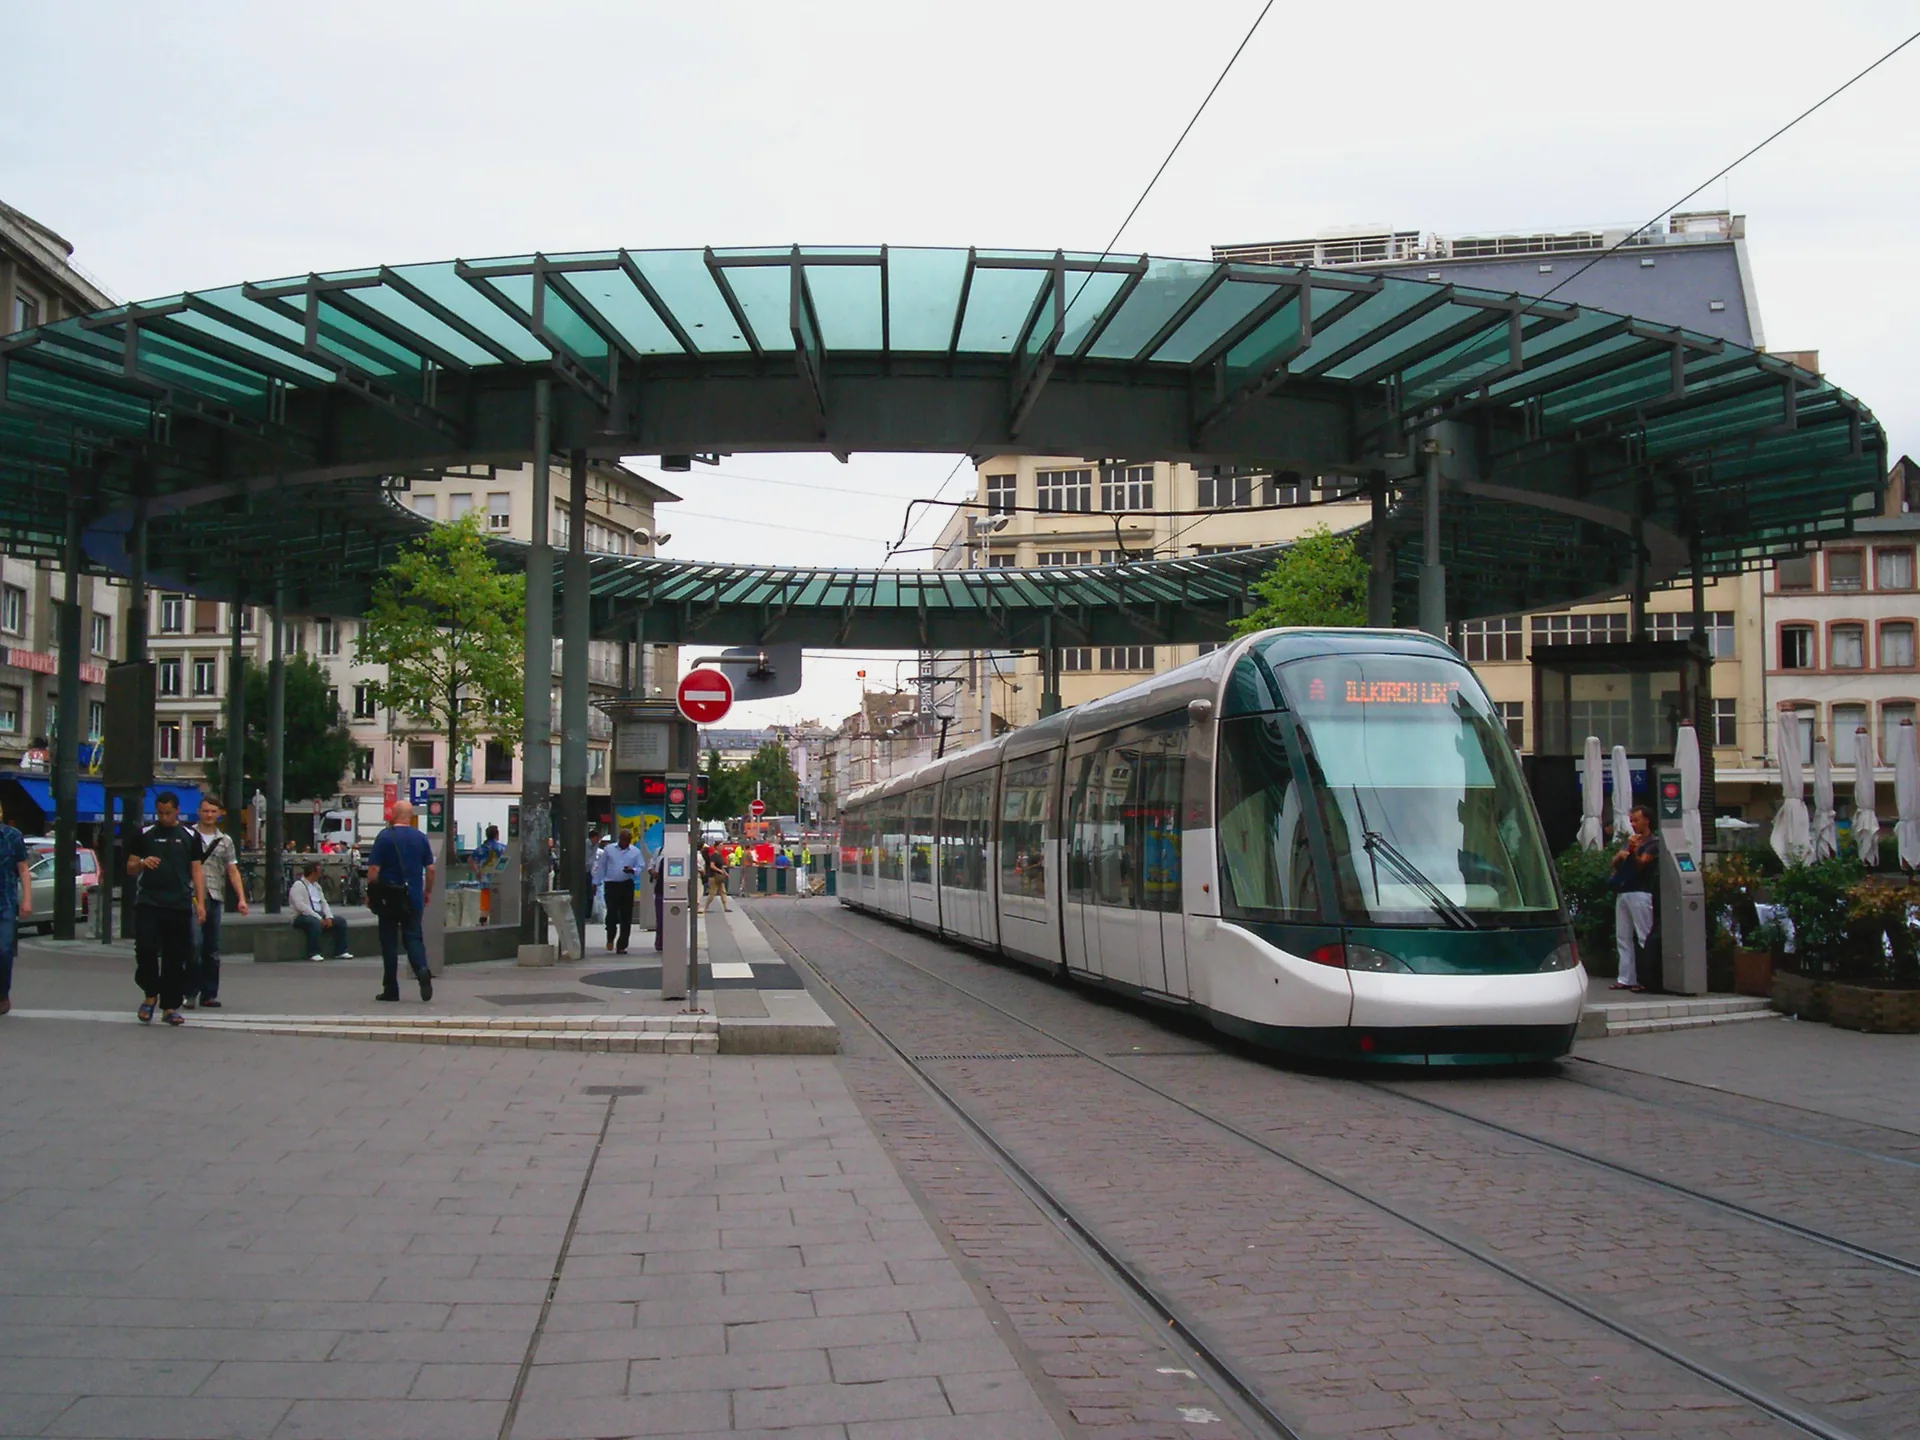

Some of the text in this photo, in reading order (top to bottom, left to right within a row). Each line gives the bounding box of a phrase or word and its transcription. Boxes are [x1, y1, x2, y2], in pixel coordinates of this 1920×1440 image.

[1309, 678, 1325, 701] A
[1346, 680, 1418, 703] ILLKIRCH
[415, 779, 430, 798] P
